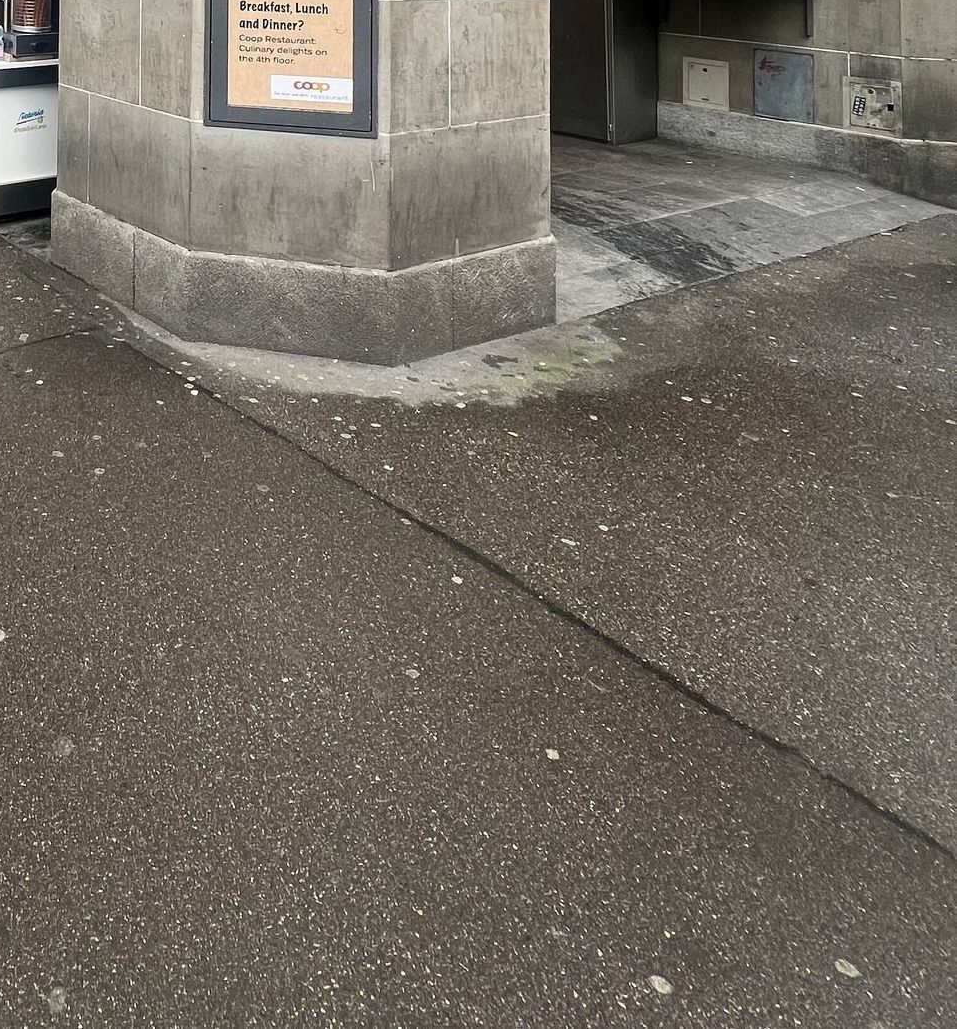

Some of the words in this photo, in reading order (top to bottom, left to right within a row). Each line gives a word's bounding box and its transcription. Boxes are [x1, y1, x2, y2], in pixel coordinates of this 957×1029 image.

[239, 0, 293, 14] Breakfast,
[295, 3, 329, 14] Lunch
[239, 18, 260, 29] and
[262, 19, 304, 31] Dinner?
[238, 34, 263, 43] Coop
[238, 45, 275, 55] Culinary
[276, 47, 313, 56] delights
[293, 81, 330, 93] coop
